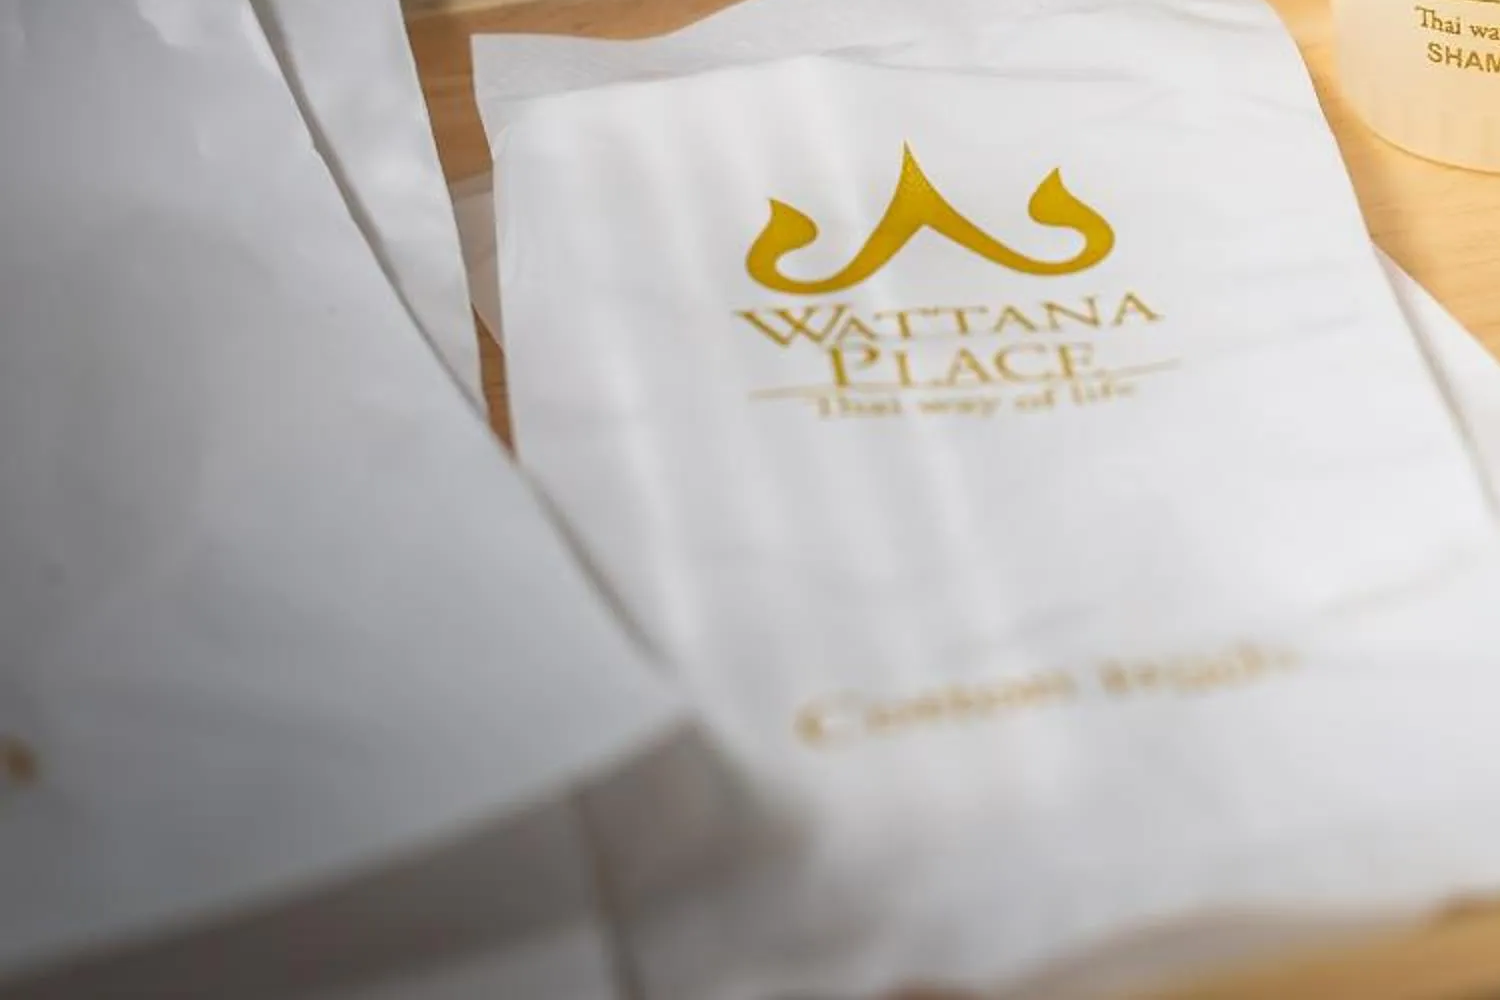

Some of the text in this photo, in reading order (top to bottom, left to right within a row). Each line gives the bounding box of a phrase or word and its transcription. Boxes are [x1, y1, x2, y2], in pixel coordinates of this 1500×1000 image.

[1414, 5, 1461, 36] Thai
[733, 291, 1164, 348] WATTANA
[827, 340, 1104, 389] PLACE
